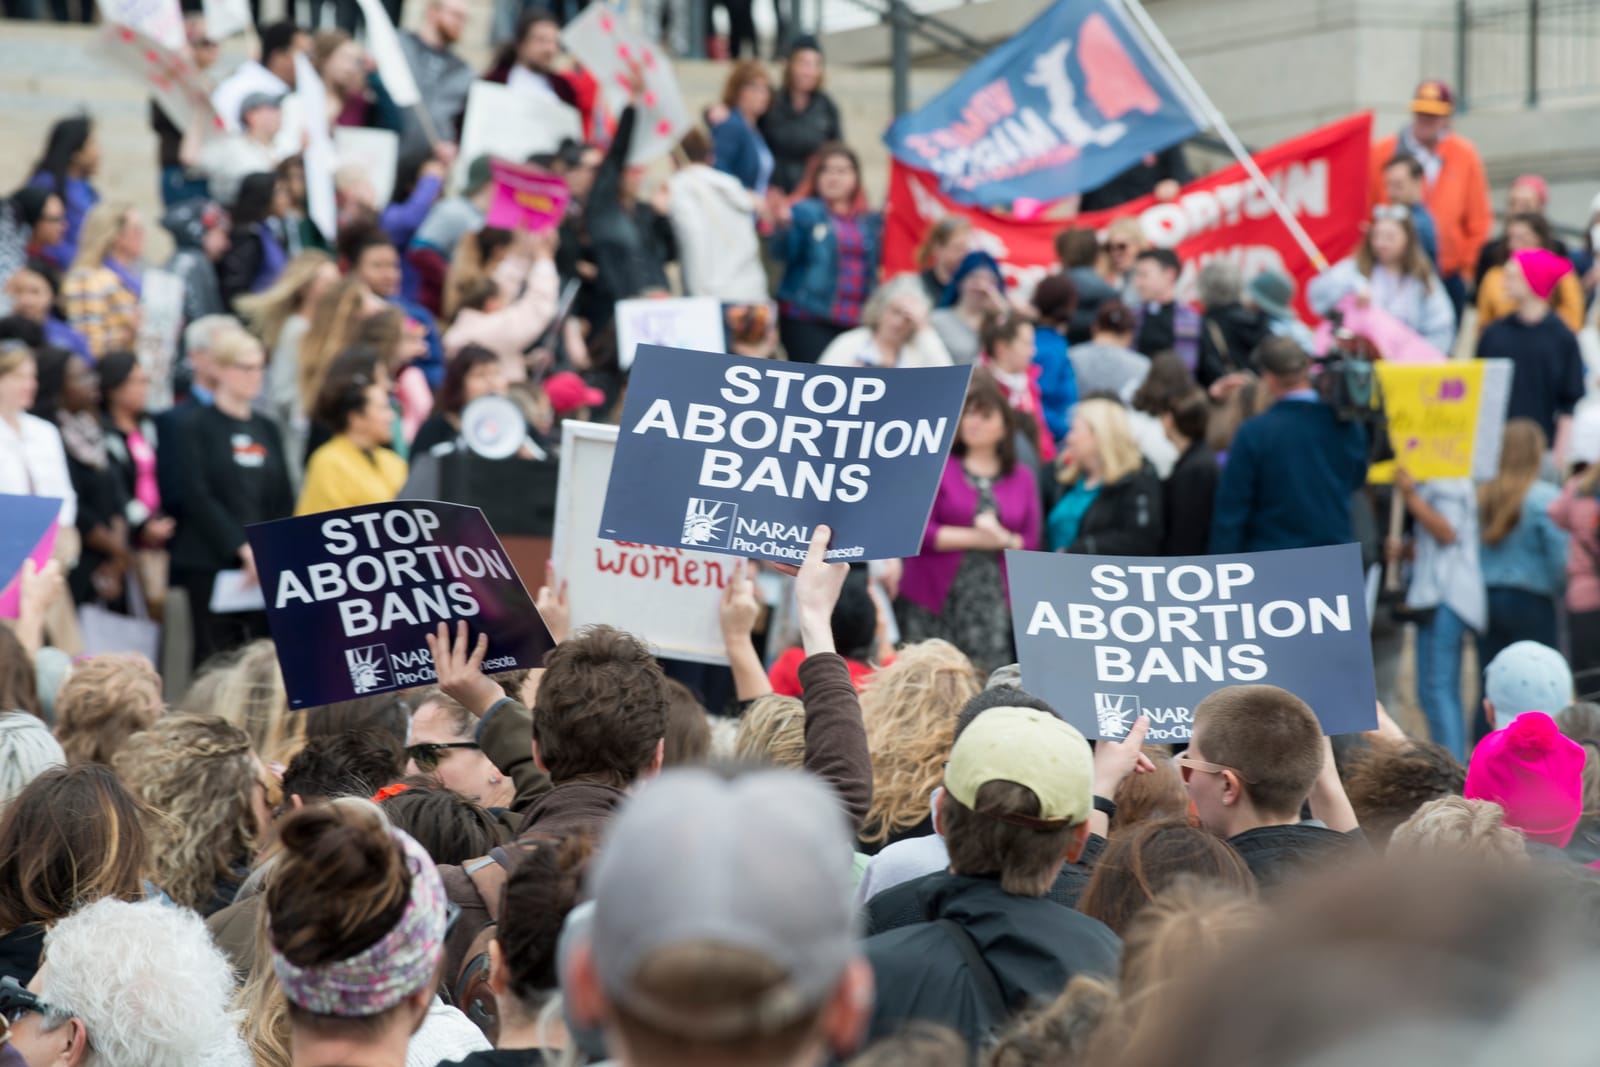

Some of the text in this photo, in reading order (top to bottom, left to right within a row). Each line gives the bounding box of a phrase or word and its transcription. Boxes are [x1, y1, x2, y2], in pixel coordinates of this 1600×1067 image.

[720, 365, 886, 415] STOP
[632, 398, 948, 460] ABORTION
[698, 448, 871, 503] BANS
[321, 508, 440, 556] STOP
[732, 537, 808, 560] Pro-Choice
[735, 516, 813, 544] NARAL
[275, 546, 512, 609] ABORTION
[1090, 562, 1255, 602] STOP
[337, 582, 480, 637] BANS
[1026, 594, 1352, 643] ABORTION
[390, 648, 435, 670] NAR
[395, 666, 437, 685] Pro-Ch
[1094, 644, 1268, 683] BANS
[1141, 706, 1194, 724] NAR
[1144, 724, 1194, 740] Pro-Ch
